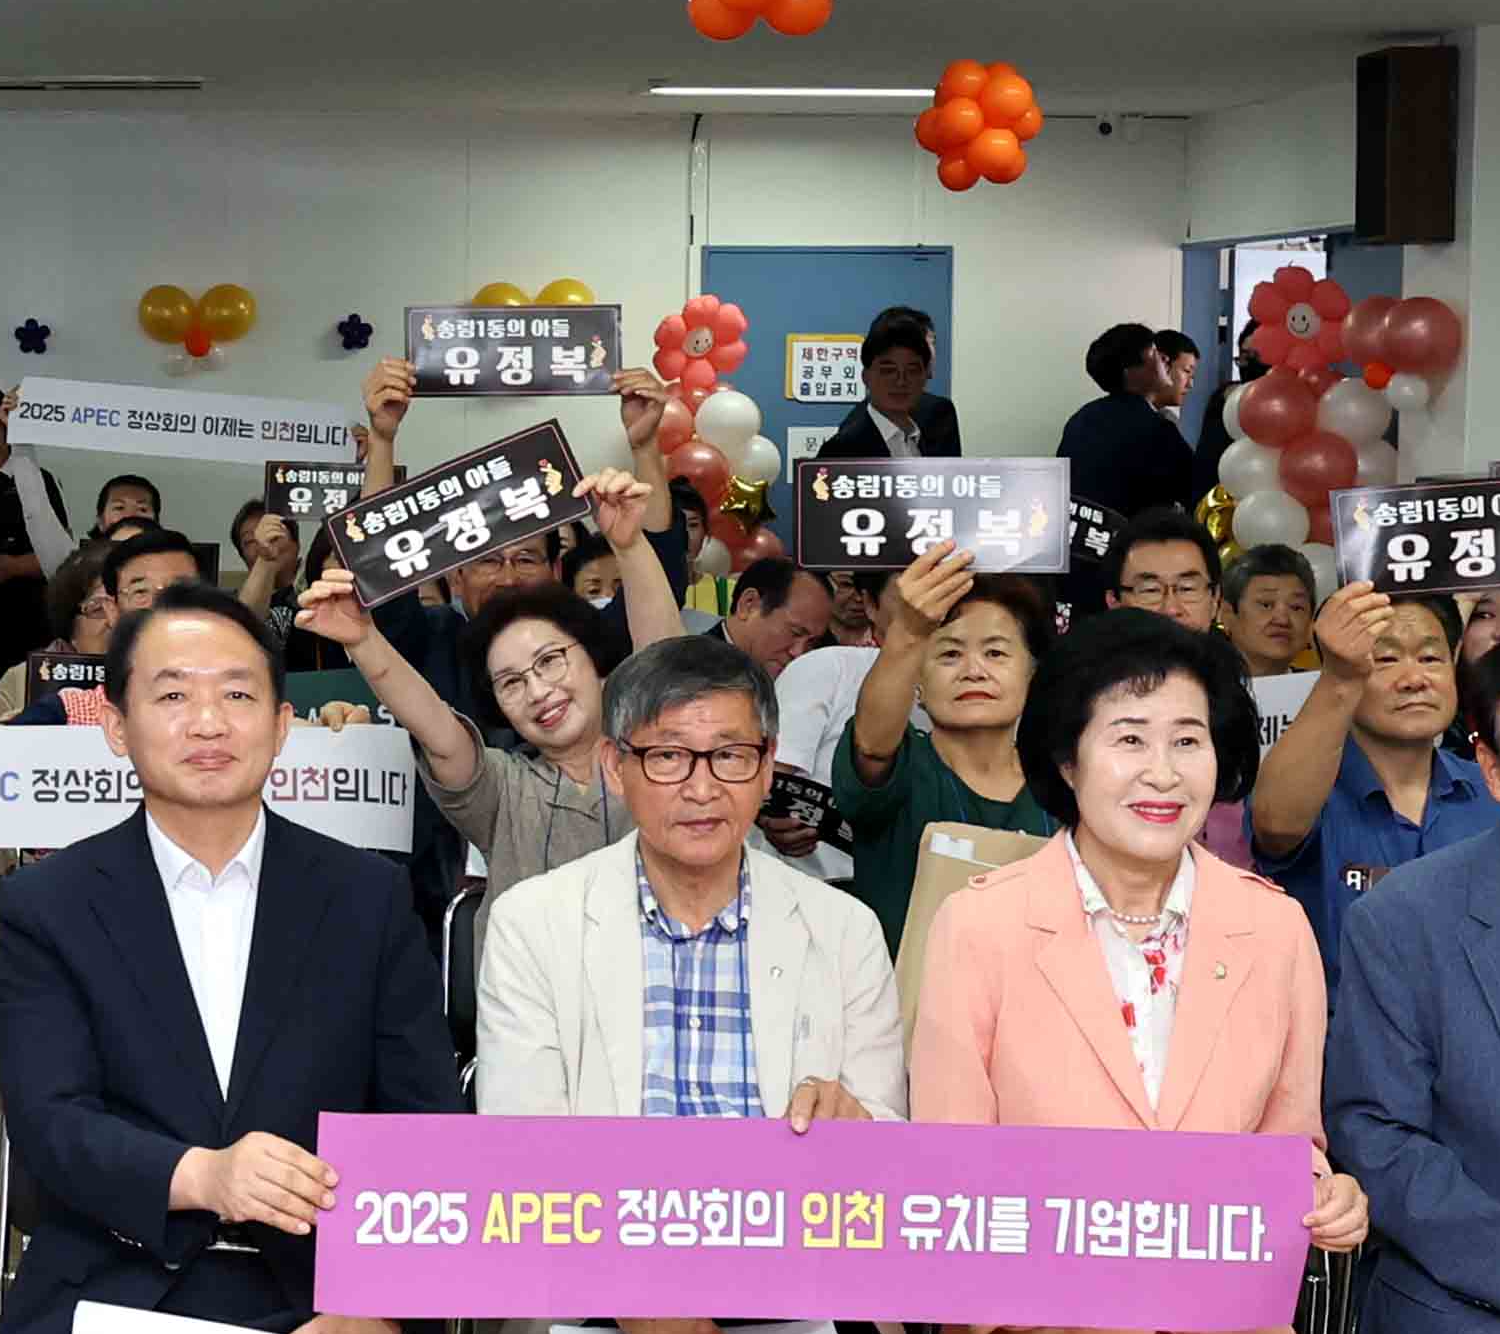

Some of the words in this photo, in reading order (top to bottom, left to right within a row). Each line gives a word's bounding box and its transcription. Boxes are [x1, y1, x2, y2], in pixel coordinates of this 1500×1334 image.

[437, 318, 526, 340] 송림1동의
[531, 317, 571, 340] 아들
[802, 347, 857, 361] 제한구역
[18, 403, 65, 424] 2025
[71, 405, 120, 427] APEC
[127, 409, 197, 435] 정상회의
[202, 414, 255, 440] 이제는
[260, 420, 349, 449] 인천입니다
[286, 469, 344, 484] 송림1동의
[831, 473, 945, 498] 송림1동의
[952, 473, 1002, 498] 아들
[362, 472, 464, 535] 송림1동의
[465, 454, 514, 498] 아들
[1372, 497, 1486, 528] 송림1동의
[269, 766, 408, 807] 인천입니다
[354, 1190, 468, 1247] 2025
[482, 1194, 603, 1245] APEC
[616, 1188, 785, 1249] 정상회의
[801, 1191, 885, 1249] 인천
[900, 1194, 1030, 1254] 유치를
[1045, 1198, 1275, 1264] 기원합니다.
